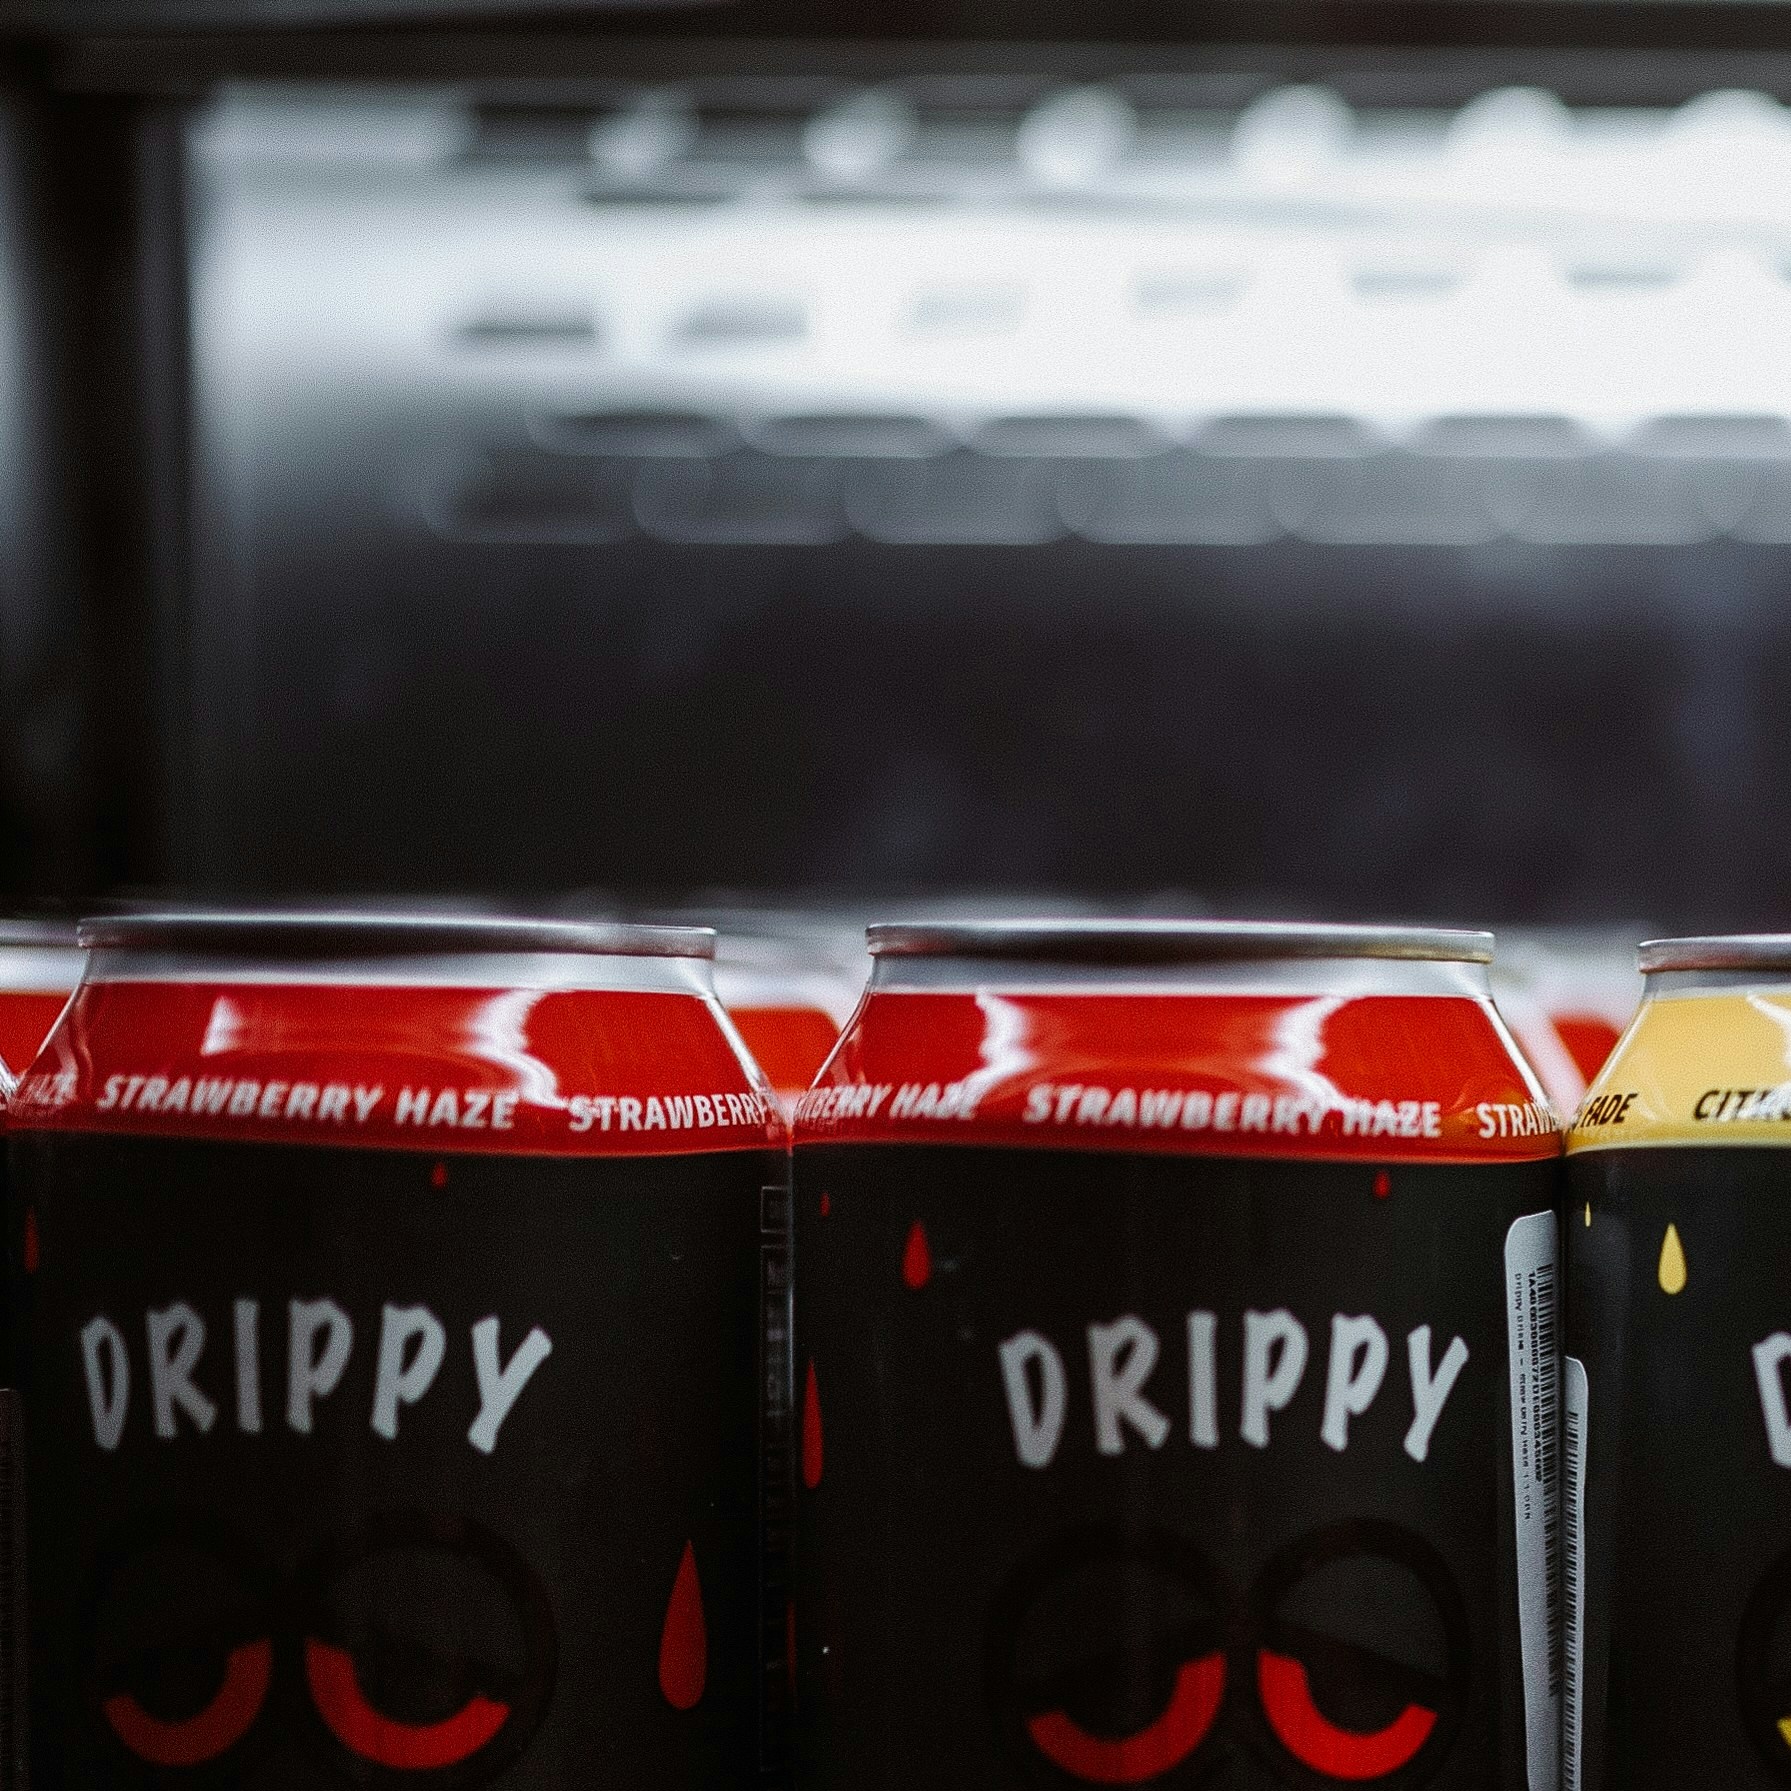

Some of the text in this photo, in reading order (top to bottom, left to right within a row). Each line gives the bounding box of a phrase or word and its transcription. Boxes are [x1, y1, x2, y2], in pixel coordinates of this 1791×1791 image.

[99, 1073, 519, 1131] STRAWBERRY HAZE
[1021, 1083, 1330, 1137] STRAWBERRY
[80, 1298, 553, 1454] DRIPPY
[1000, 1308, 1470, 1470] DRIPPY
